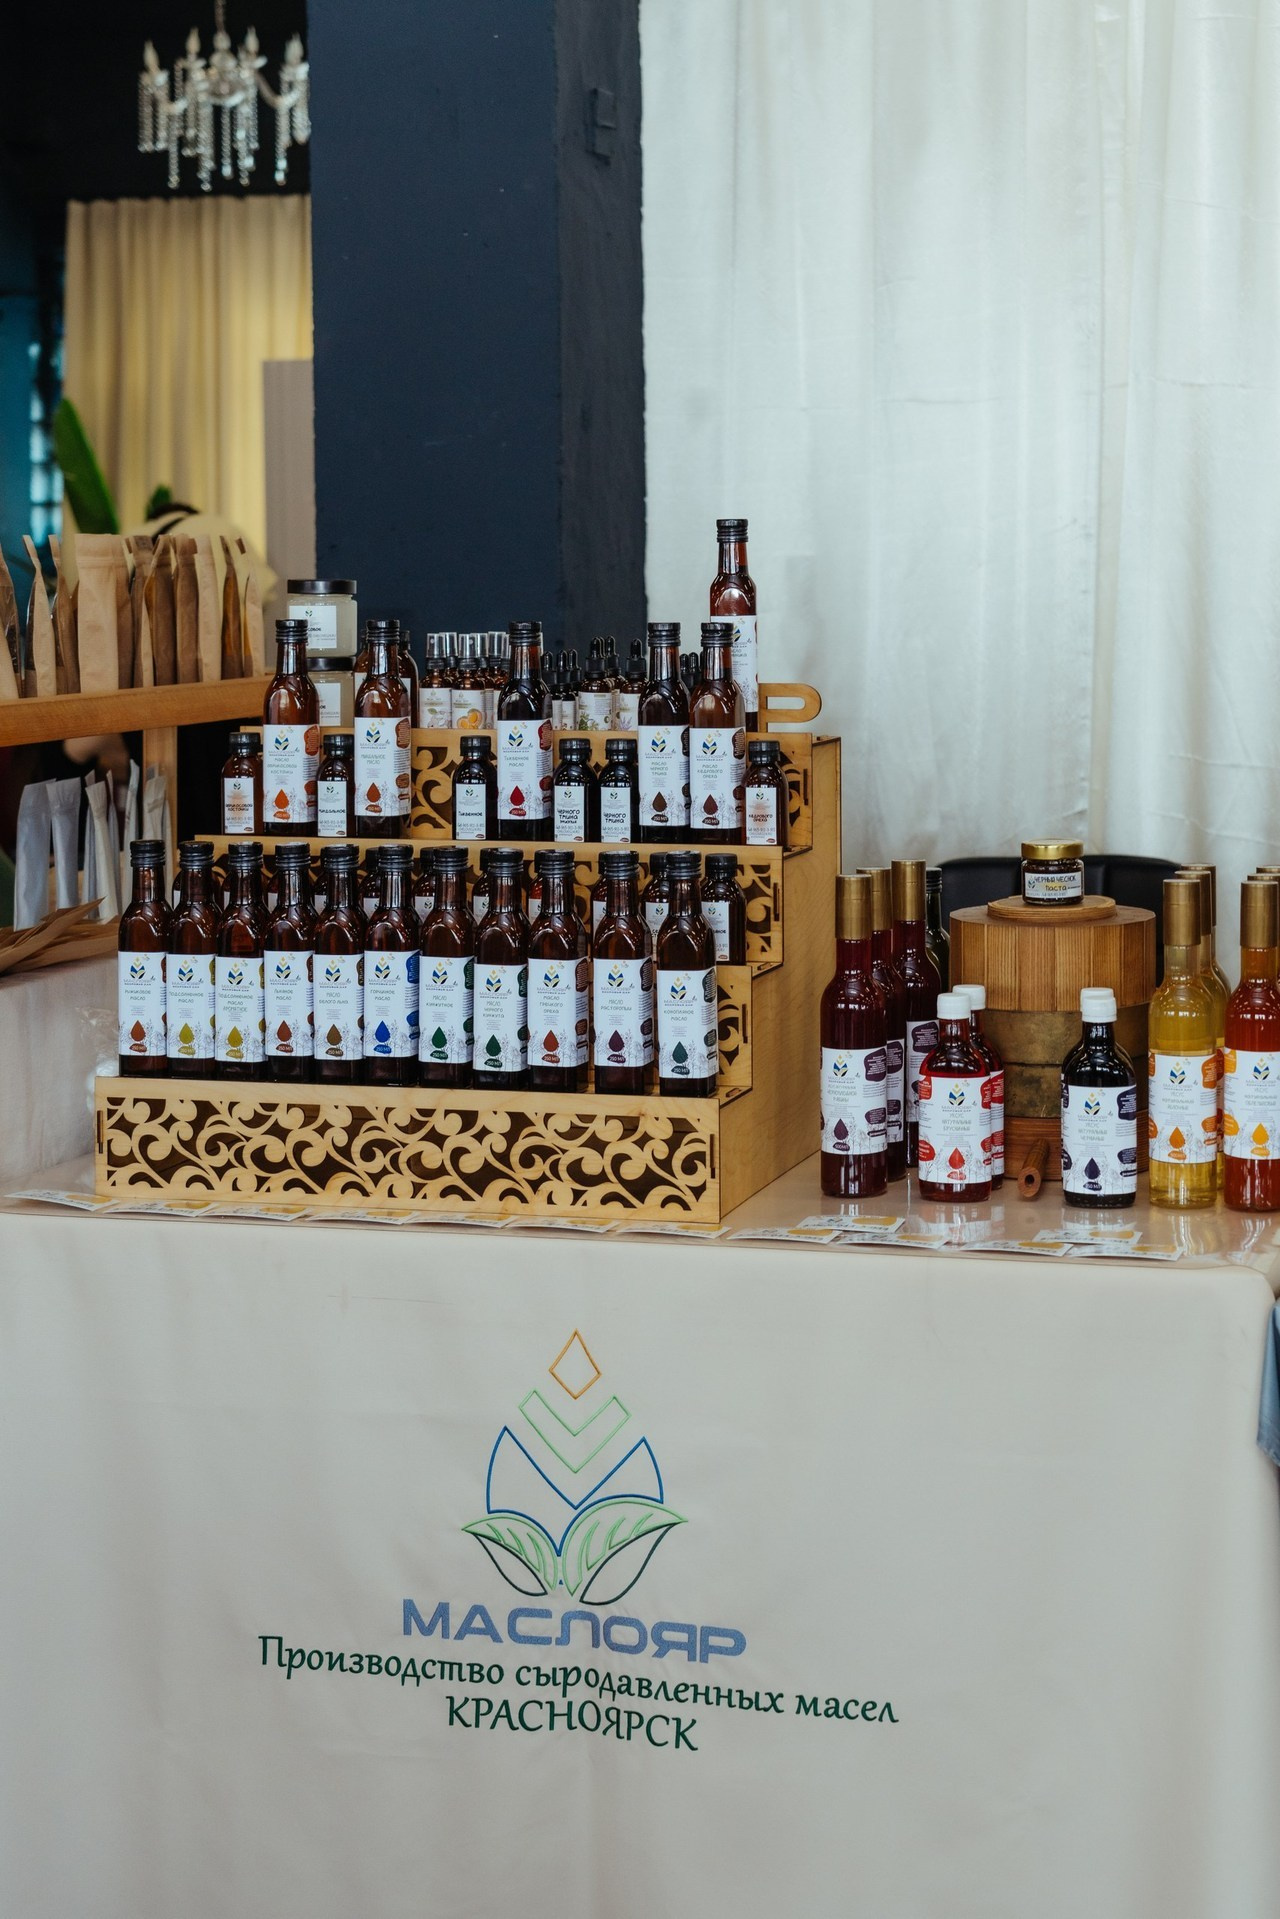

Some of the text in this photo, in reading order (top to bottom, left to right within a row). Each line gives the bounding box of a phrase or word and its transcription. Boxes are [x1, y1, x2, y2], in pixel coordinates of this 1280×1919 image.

[402, 1598, 746, 1664] МАСЛОЯР
[258, 1634, 900, 1724] Производство сыродавленных масел
[446, 1696, 698, 1752] КРАСНОЯРСК
